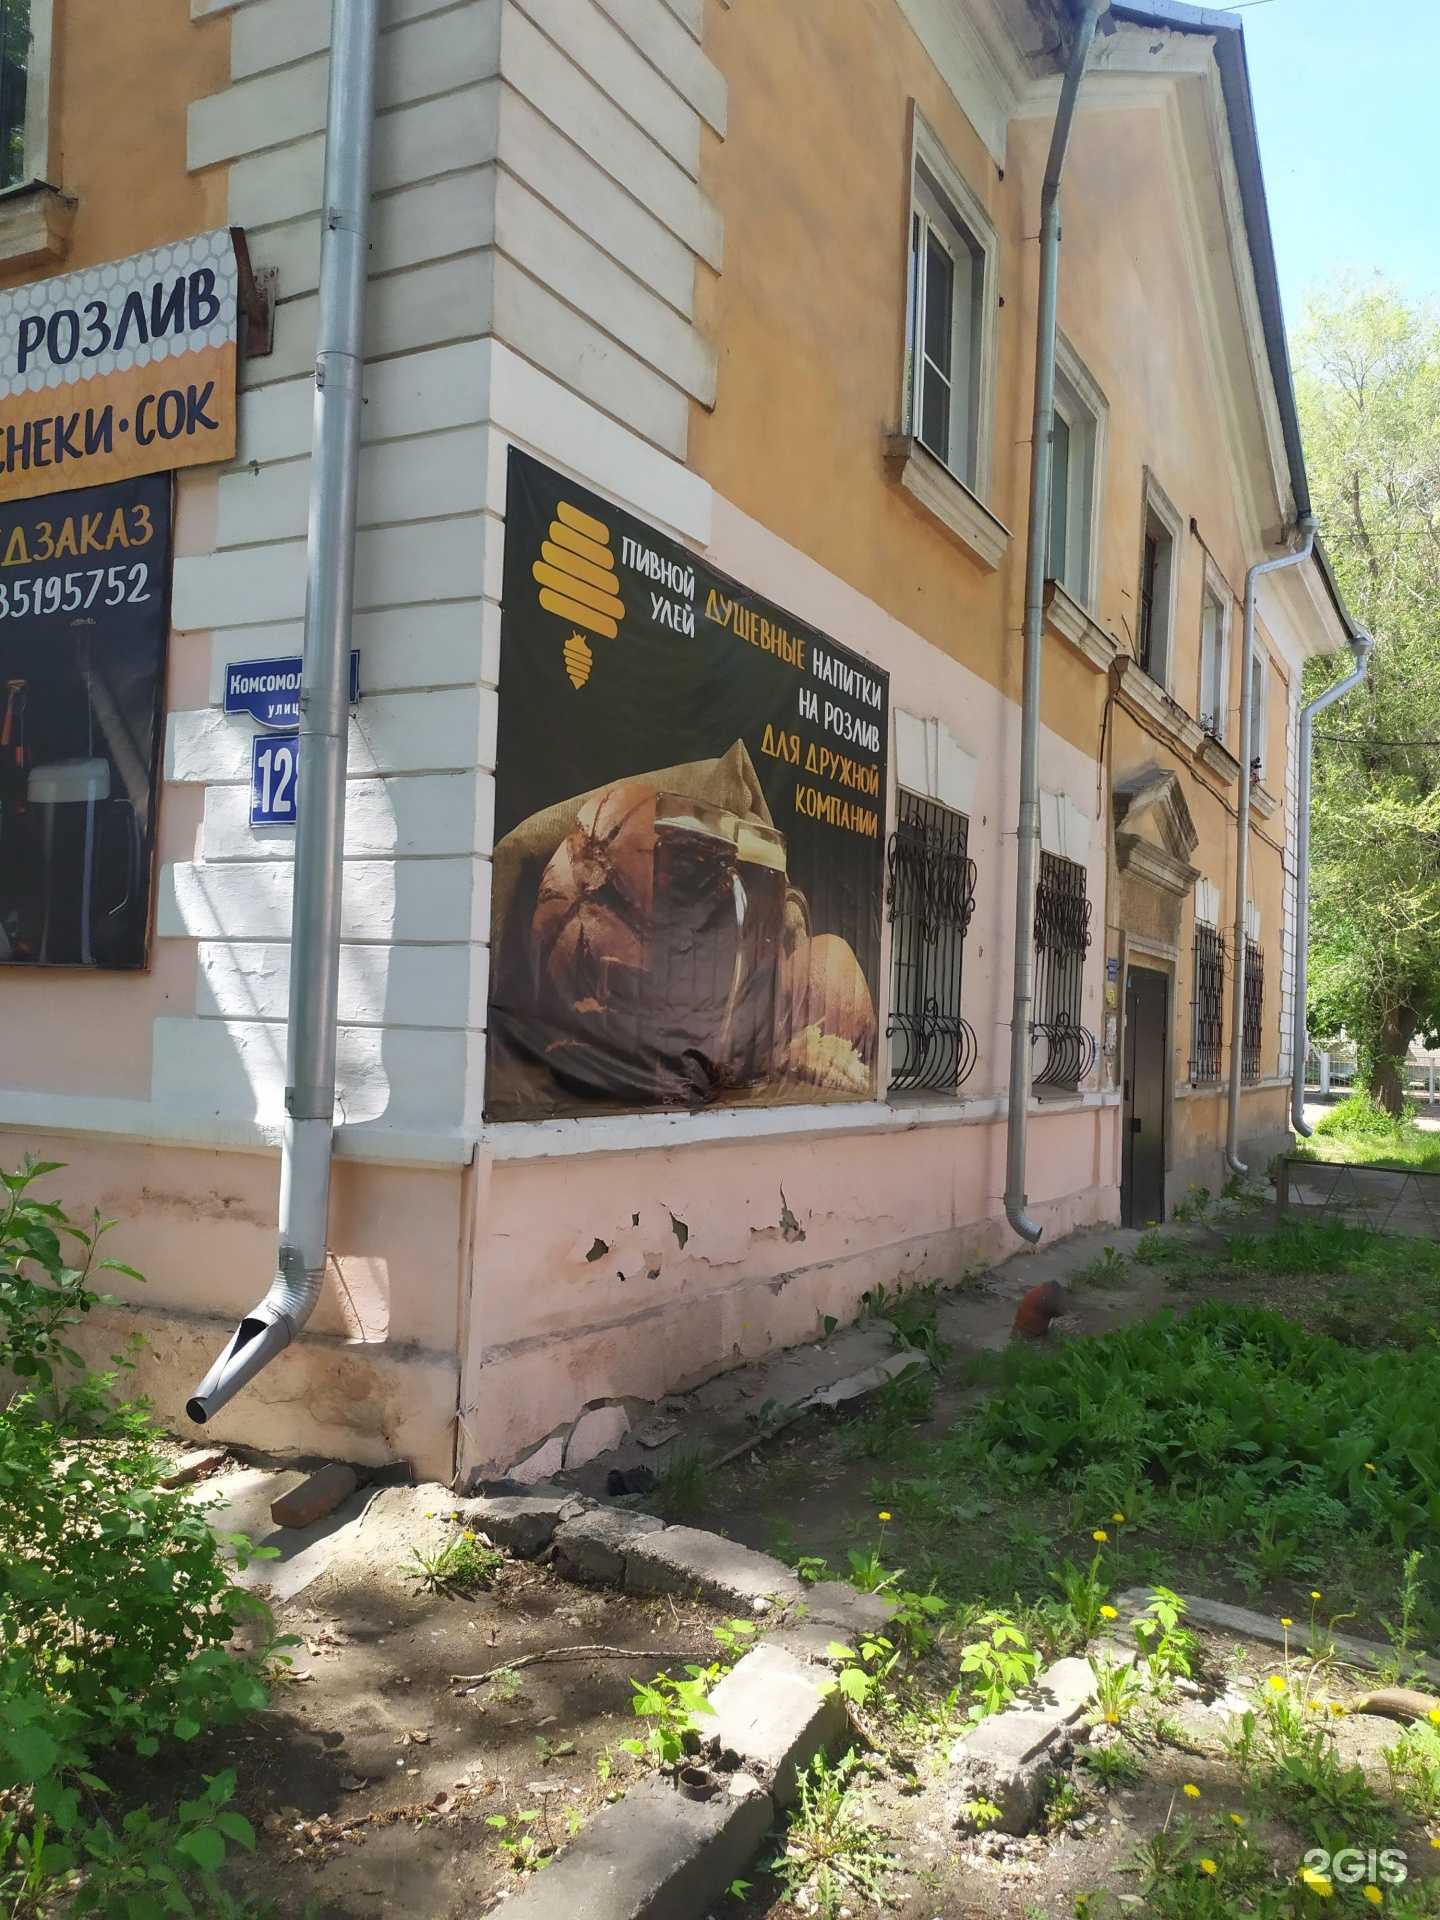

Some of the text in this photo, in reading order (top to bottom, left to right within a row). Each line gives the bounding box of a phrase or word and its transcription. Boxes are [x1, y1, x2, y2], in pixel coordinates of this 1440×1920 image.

[17, 267, 221, 374] РОЗЛИВ
[0, 504, 154, 566] ДЗАКАЗ
[621, 535, 695, 601] ПИВНОЙ
[650, 591, 695, 638] УЛЕЙ
[704, 588, 882, 711] ДУШЕВНЫЕ НАПИТКИ
[799, 687, 880, 753] НА РОЗЛИВ
[258, 748, 300, 813] 12
[760, 723, 880, 798] ДЛЯ ДРУЖНОЙ
[795, 783, 878, 839] КОМПАНИИ
